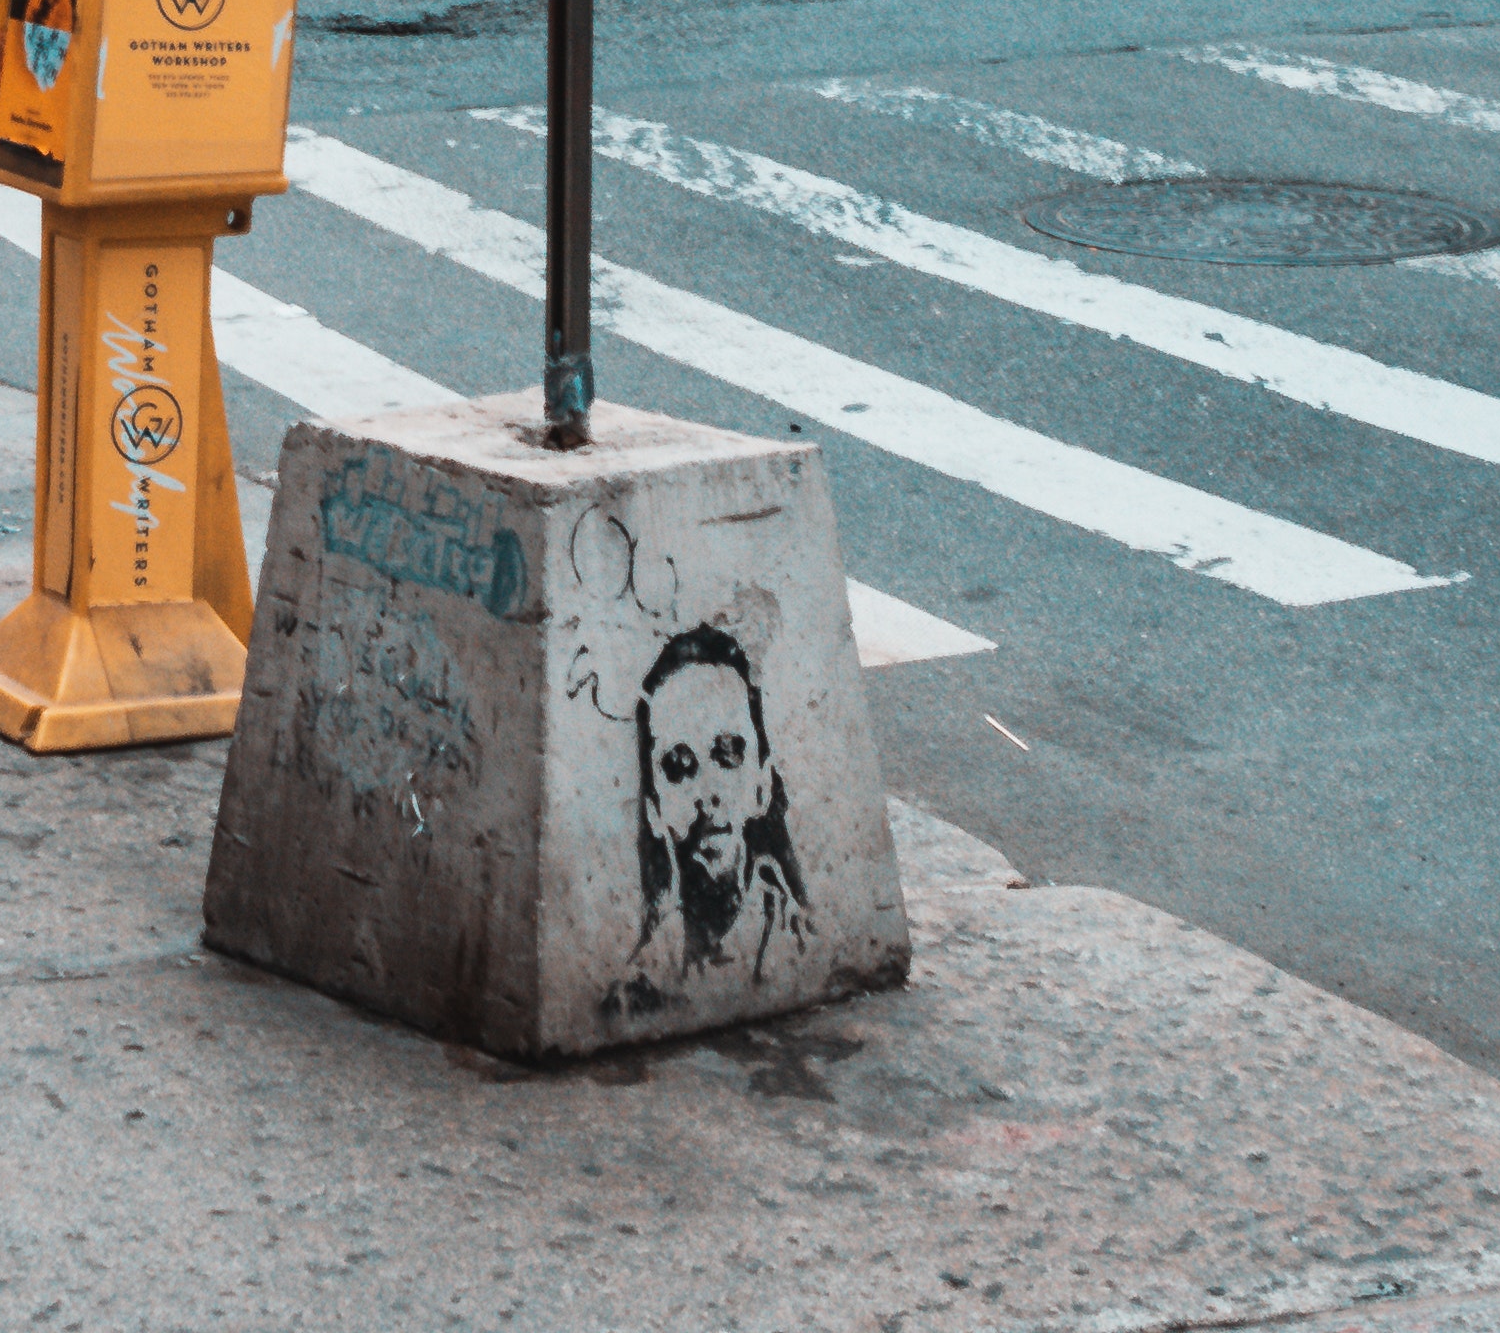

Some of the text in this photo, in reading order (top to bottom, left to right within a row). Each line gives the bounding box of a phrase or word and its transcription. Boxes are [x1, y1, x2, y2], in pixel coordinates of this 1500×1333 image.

[129, 39, 251, 52] GOTHAM WRITERS
[152, 55, 227, 67] WORKSHOP
[143, 263, 160, 374] GOTHAM
[133, 475, 155, 589] WRITERS
